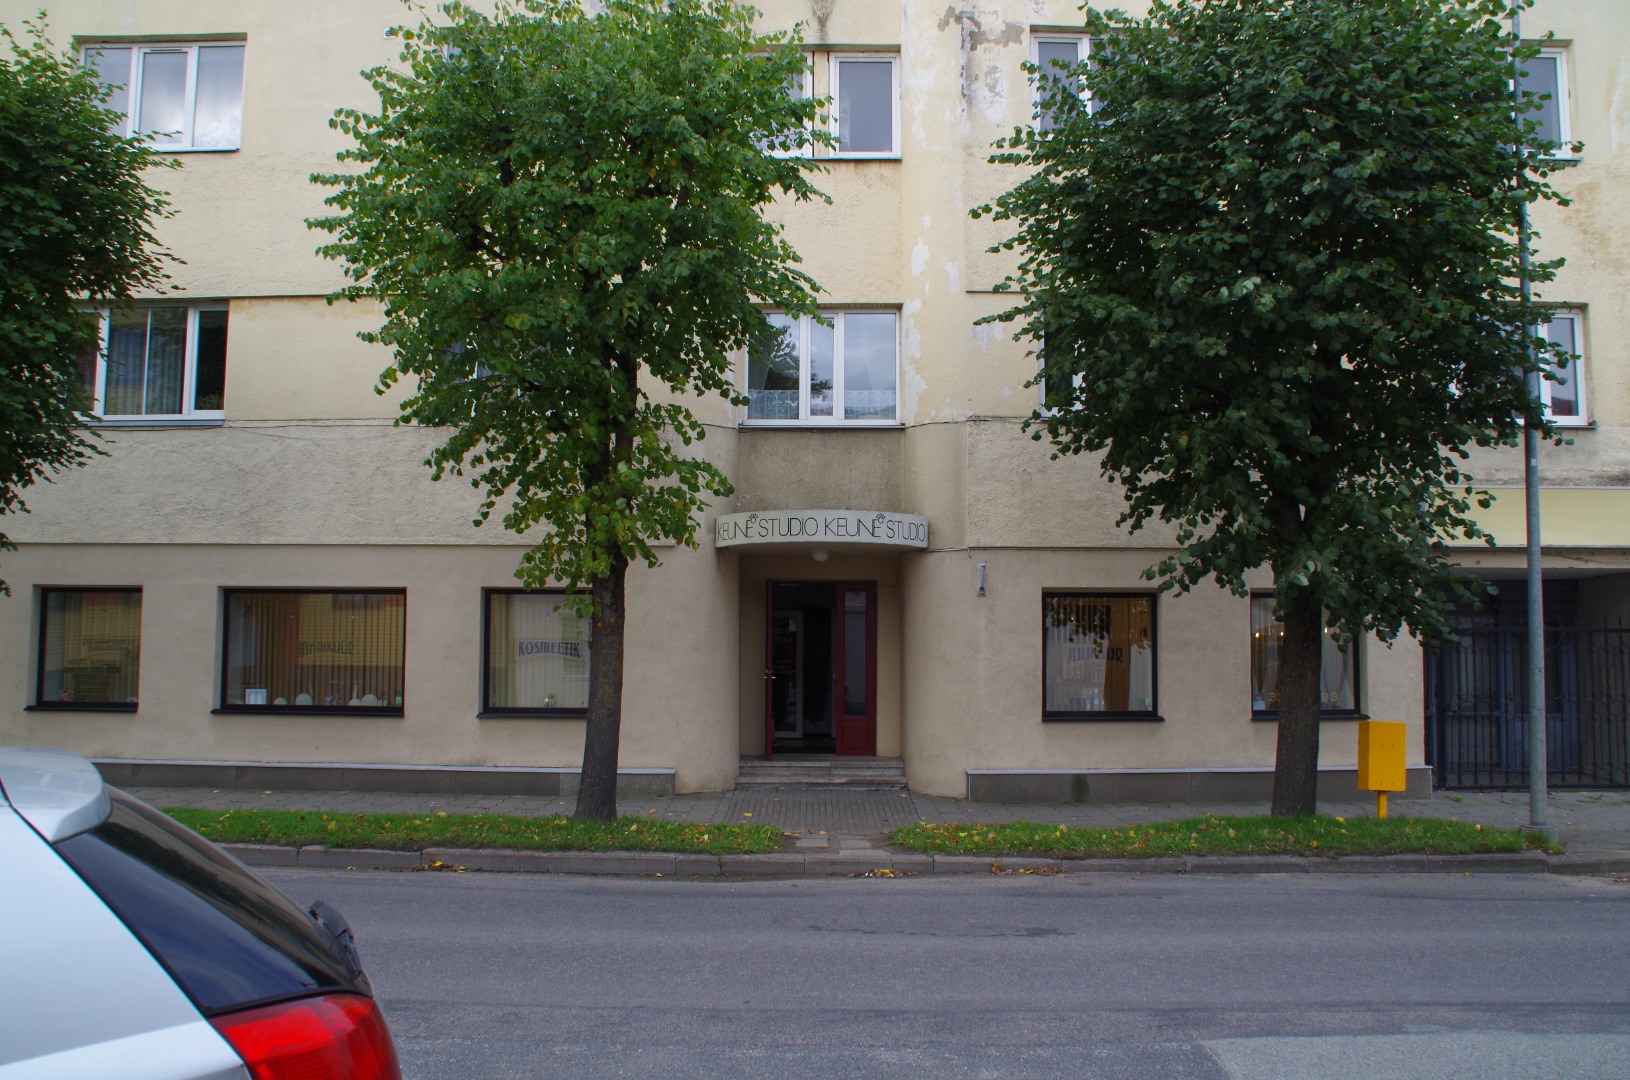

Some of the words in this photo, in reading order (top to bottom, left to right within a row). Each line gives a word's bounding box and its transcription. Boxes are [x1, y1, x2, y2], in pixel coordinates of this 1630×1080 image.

[717, 518, 754, 541] KEUNE
[758, 517, 819, 537] STUDIO
[824, 517, 882, 538] KEUNE
[886, 519, 926, 542] STUDIO
[518, 641, 580, 658] KOSMEETIK
